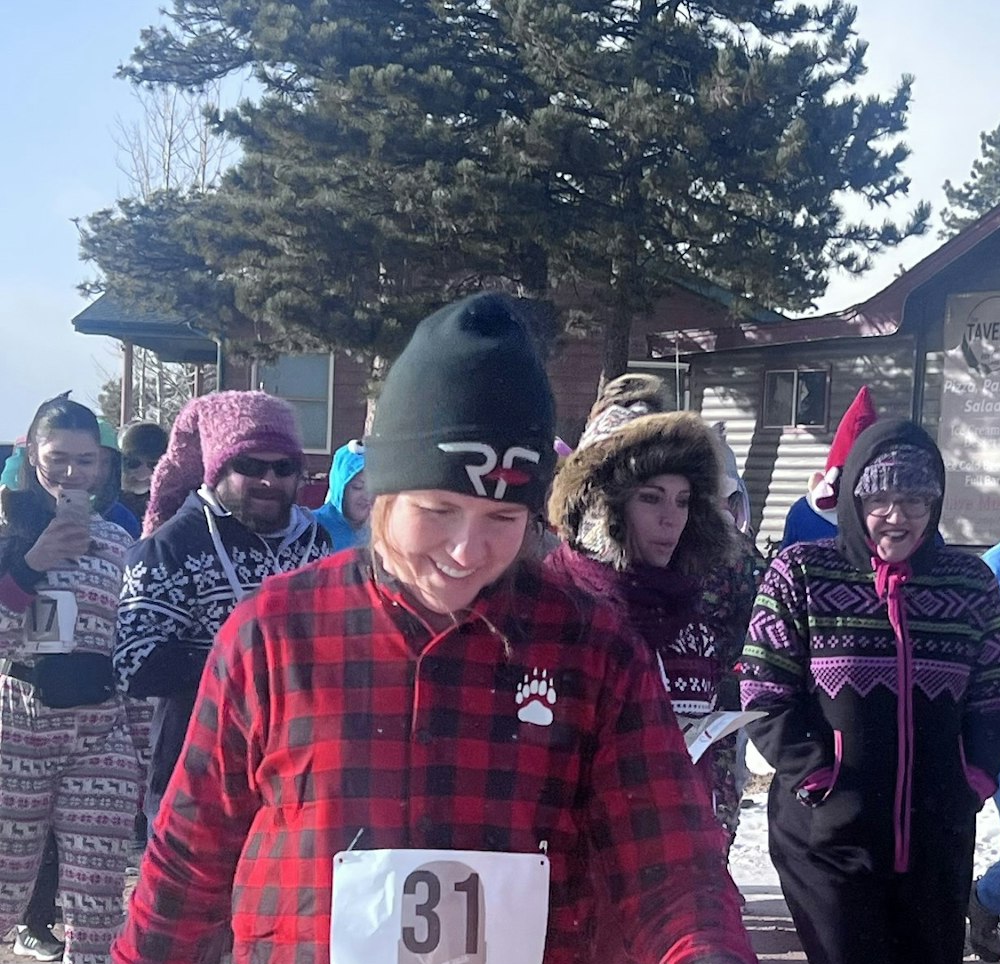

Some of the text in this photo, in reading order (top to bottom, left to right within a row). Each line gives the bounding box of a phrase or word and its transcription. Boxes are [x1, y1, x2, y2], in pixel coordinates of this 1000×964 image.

[943, 379, 978, 394] Pizza,
[965, 474, 1000, 487] Full Bar
[402, 870, 480, 954] 31
